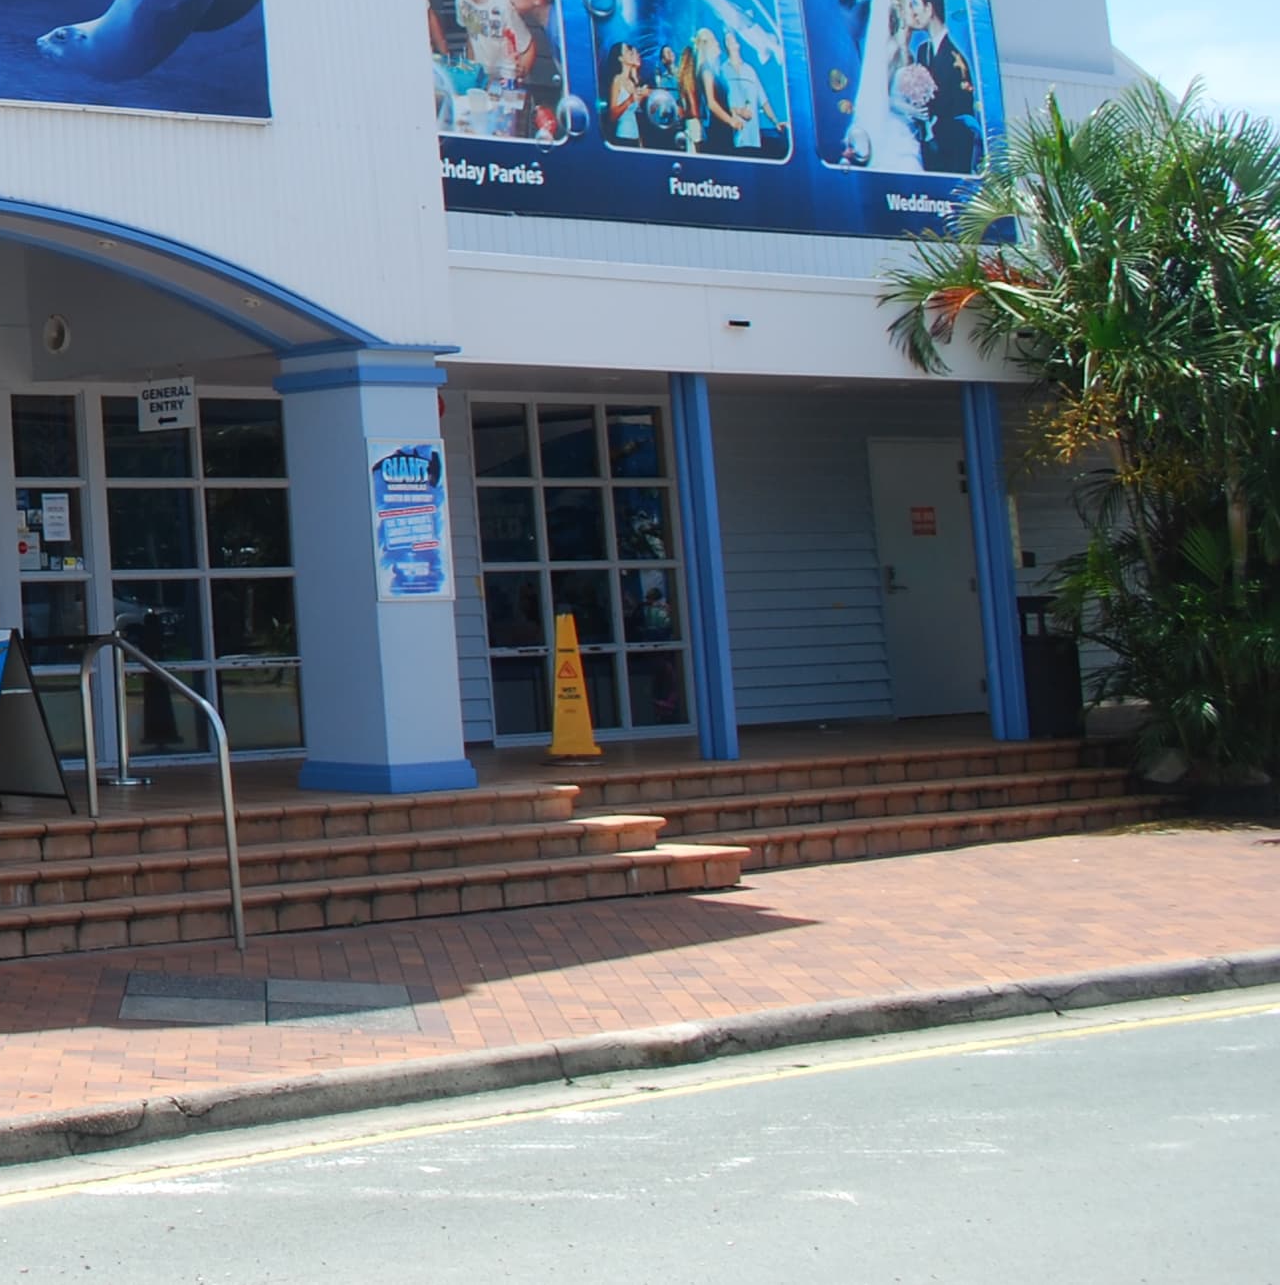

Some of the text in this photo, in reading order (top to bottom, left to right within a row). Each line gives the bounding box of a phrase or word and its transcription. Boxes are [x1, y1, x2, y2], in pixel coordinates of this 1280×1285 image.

[489, 163, 544, 185] Parties
[669, 177, 740, 200] Functions
[886, 194, 953, 217] Weddings
[142, 385, 192, 401] GENERAL
[149, 399, 185, 414] ENTRY
[382, 457, 429, 483] GIANT
